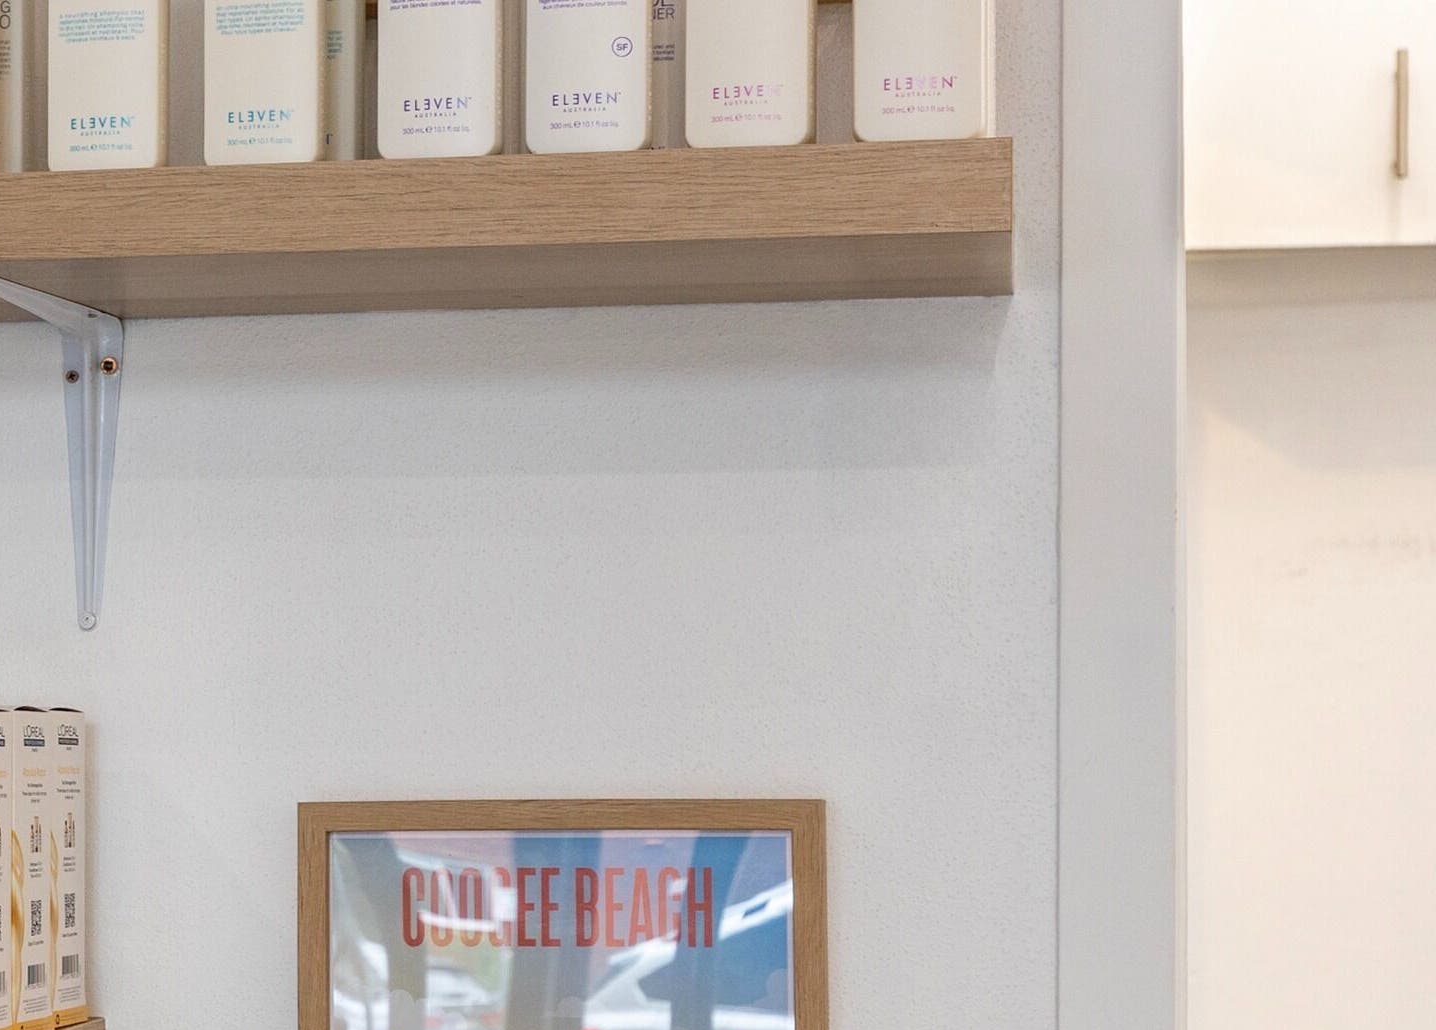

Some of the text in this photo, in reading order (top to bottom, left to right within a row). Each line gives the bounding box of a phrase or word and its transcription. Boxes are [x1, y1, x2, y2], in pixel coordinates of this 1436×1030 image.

[616, 42, 628, 51] SF
[883, 76, 955, 91] ELEVEN
[552, 92, 617, 107] ELEVEN
[713, 84, 781, 100] ELEVEN
[404, 97, 468, 112] ELEVEN
[71, 116, 131, 131] ELEVEN
[228, 109, 291, 124] ELEVEN
[401, 866, 713, 948] COOGEE BEACH
